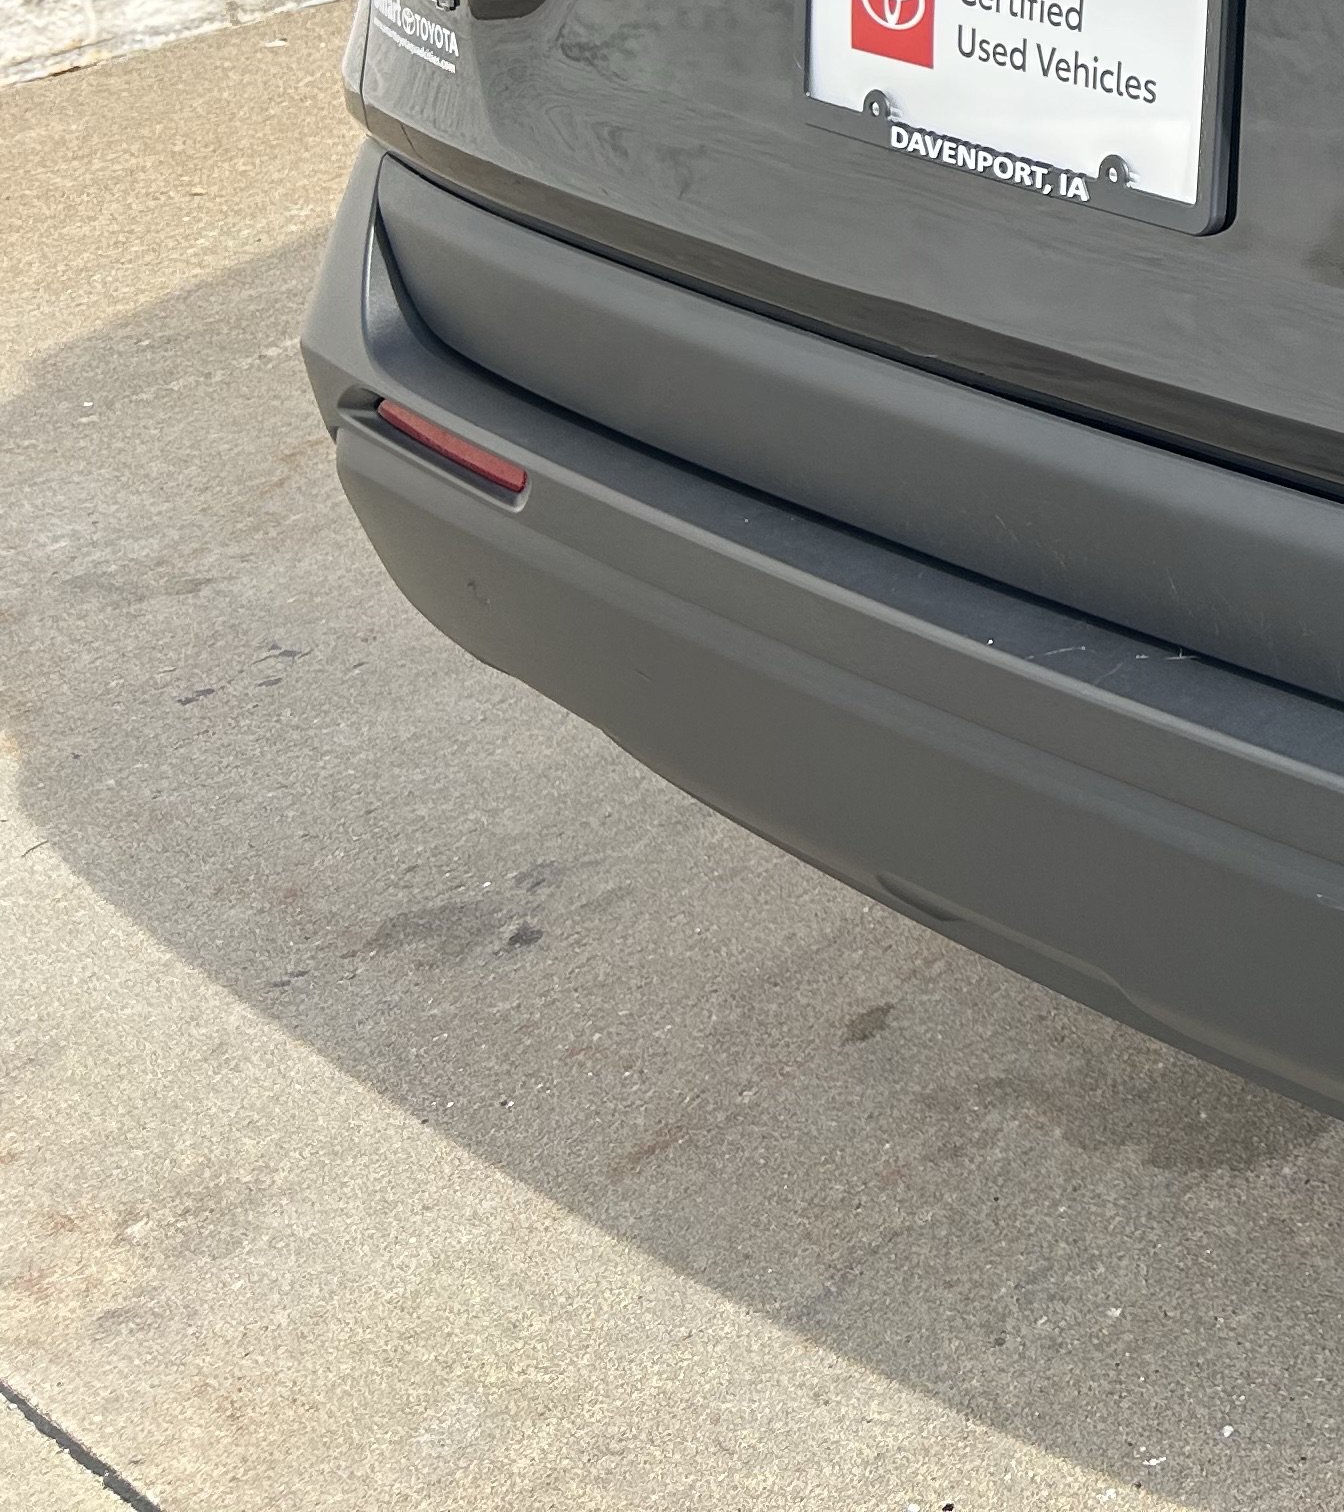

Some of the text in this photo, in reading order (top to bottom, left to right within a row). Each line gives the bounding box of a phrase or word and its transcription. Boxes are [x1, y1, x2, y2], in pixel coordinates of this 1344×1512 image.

[414, 14, 460, 58] TOYOTA
[957, 24, 1157, 104] Used Vehicles
[890, 125, 1090, 202] DAVENPORT, IA
